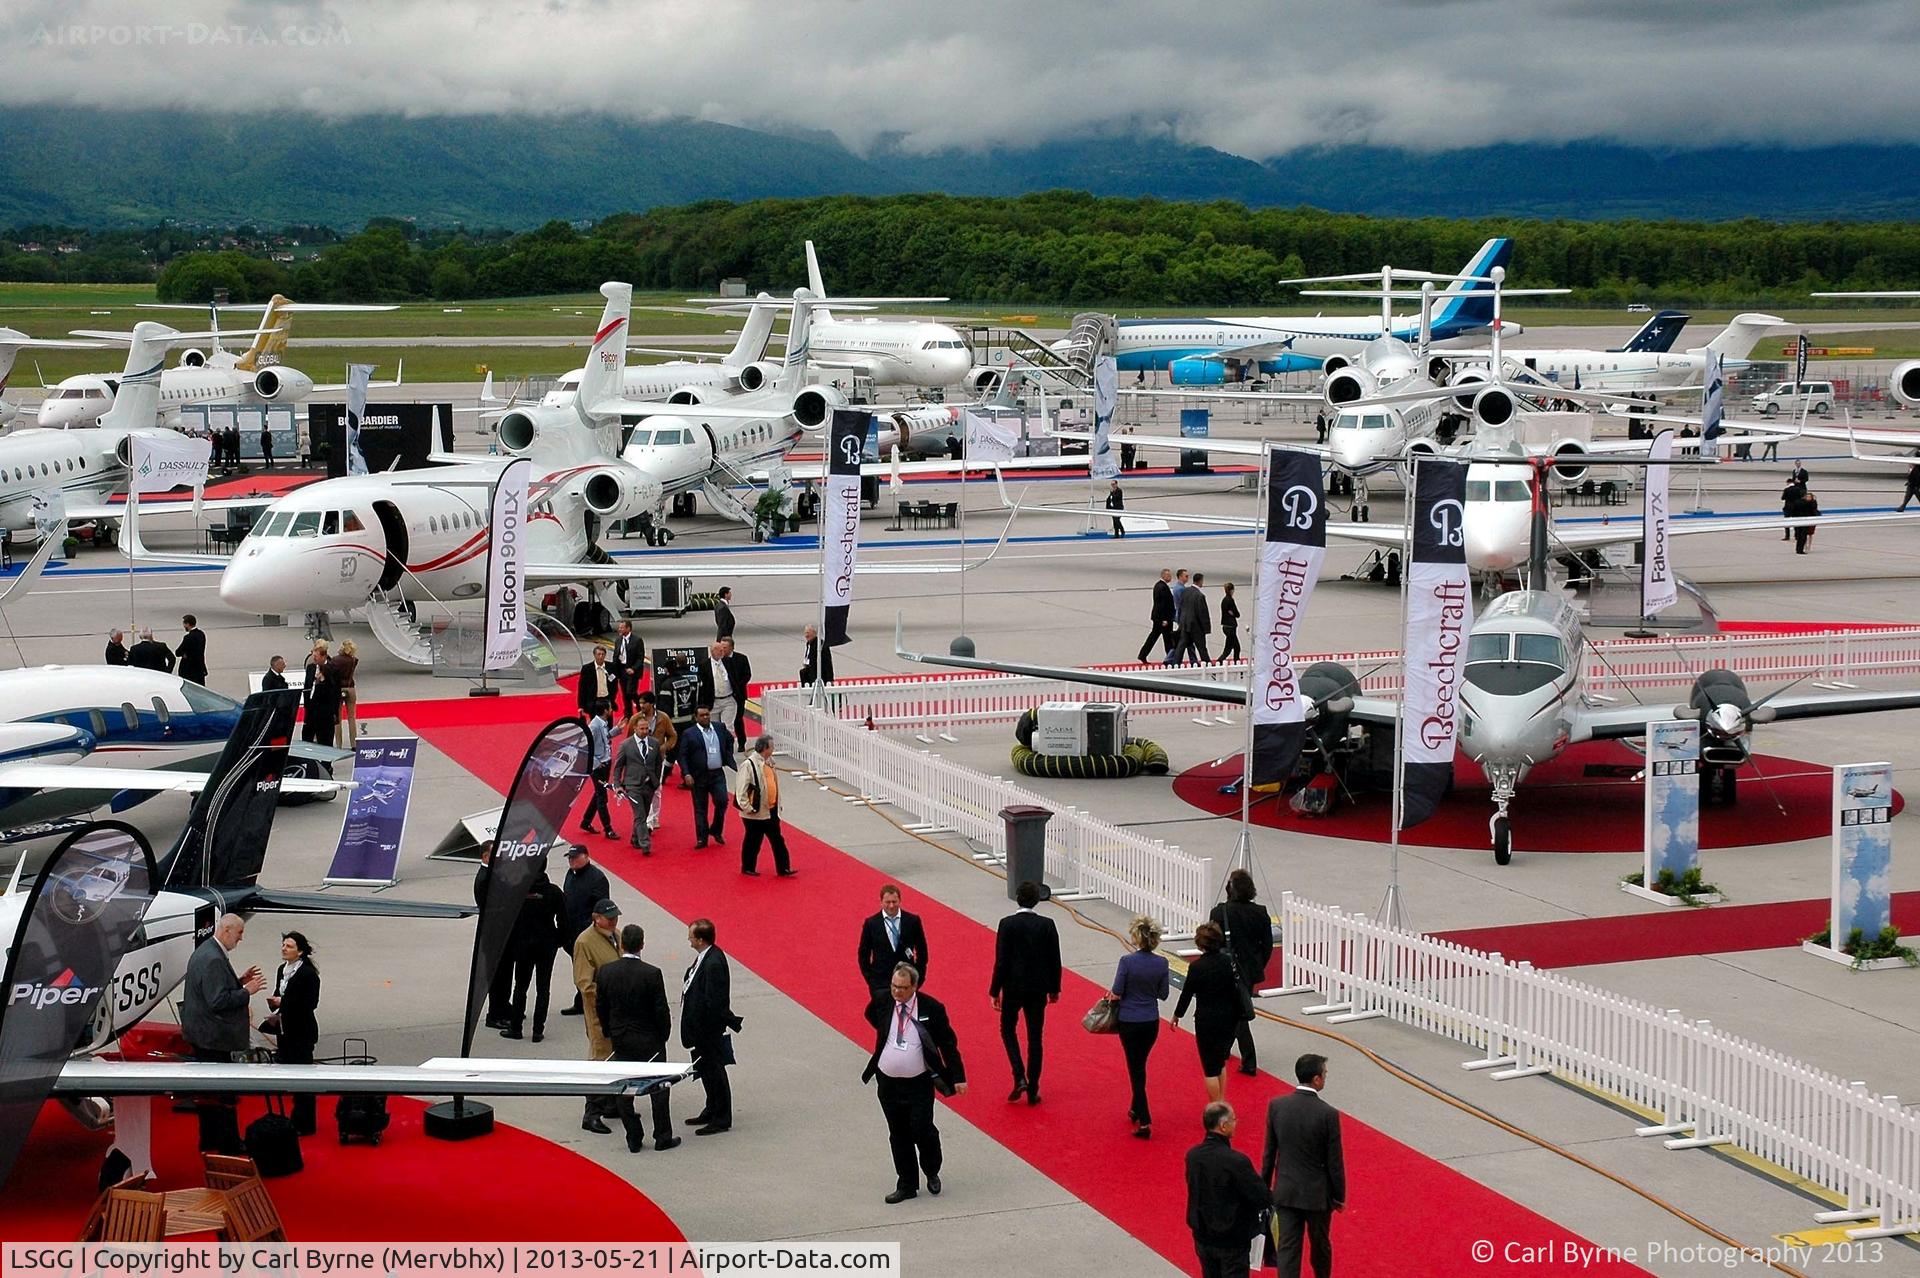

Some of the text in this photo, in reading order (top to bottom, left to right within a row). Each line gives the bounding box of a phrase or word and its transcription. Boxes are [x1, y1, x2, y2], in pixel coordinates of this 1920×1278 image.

[159, 461, 207, 470] DASSAULT
[499, 489, 520, 634] Falcon 900LX
[835, 486, 859, 598] Beechcraft
[1651, 492, 1666, 583] Falcon 7X
[1265, 556, 1308, 712] Beechcraft
[1420, 579, 1466, 750] Beechcraft
[256, 780, 280, 792] Piper
[495, 840, 548, 861] Piper
[197, 925, 214, 938] Piper
[8, 982, 98, 1010] Piper
